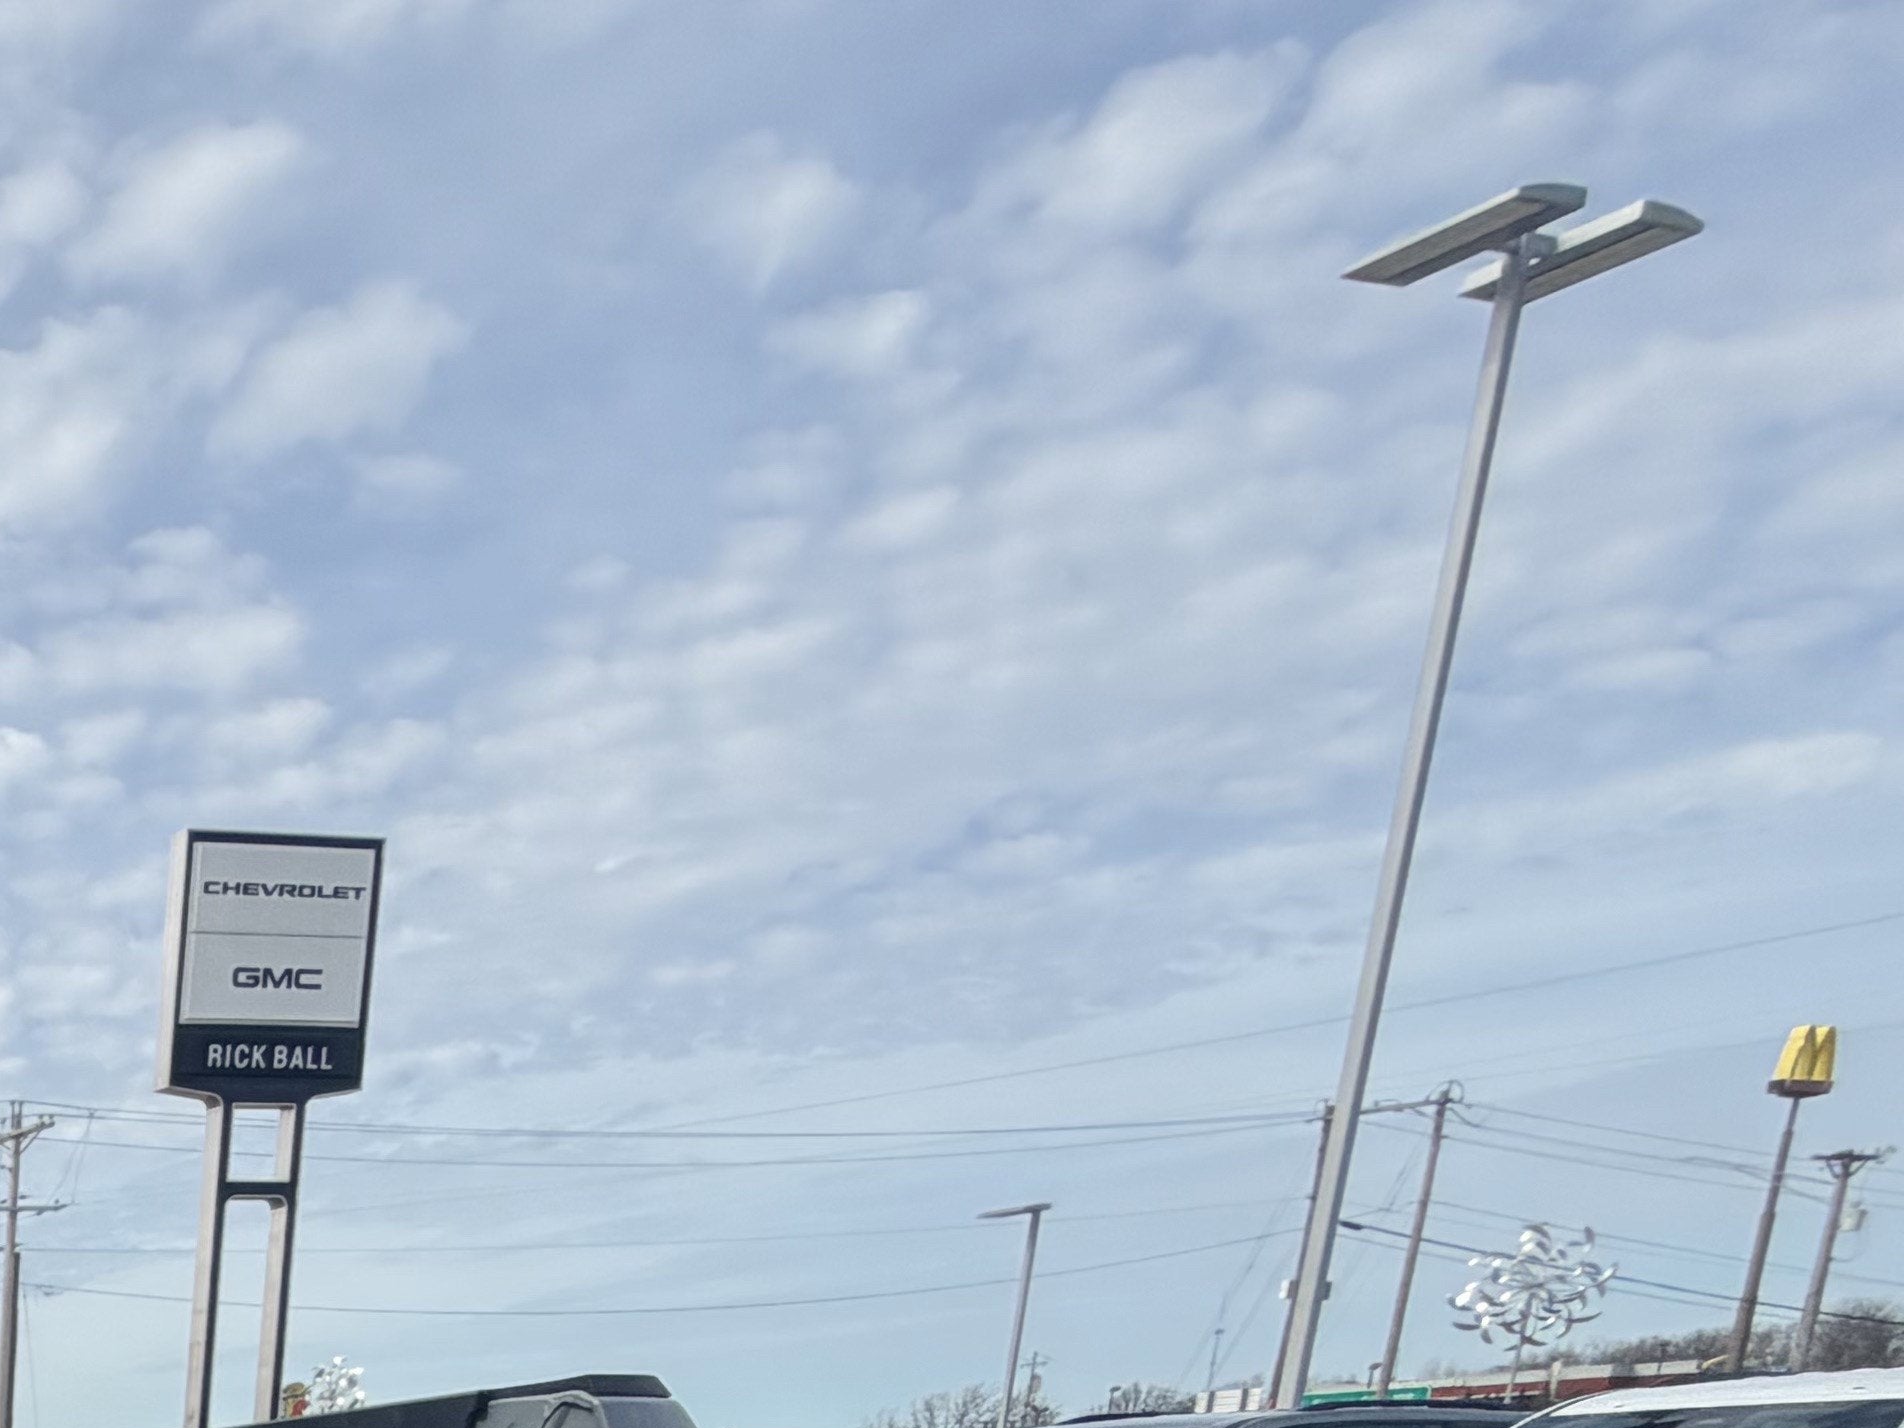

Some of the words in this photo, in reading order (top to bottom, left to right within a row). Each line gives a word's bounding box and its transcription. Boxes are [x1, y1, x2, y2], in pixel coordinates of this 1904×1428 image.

[203, 882, 366, 900] CHEVROLET
[233, 966, 323, 989] GMC
[207, 1044, 266, 1069] RICK
[273, 1045, 332, 1070] BALL
